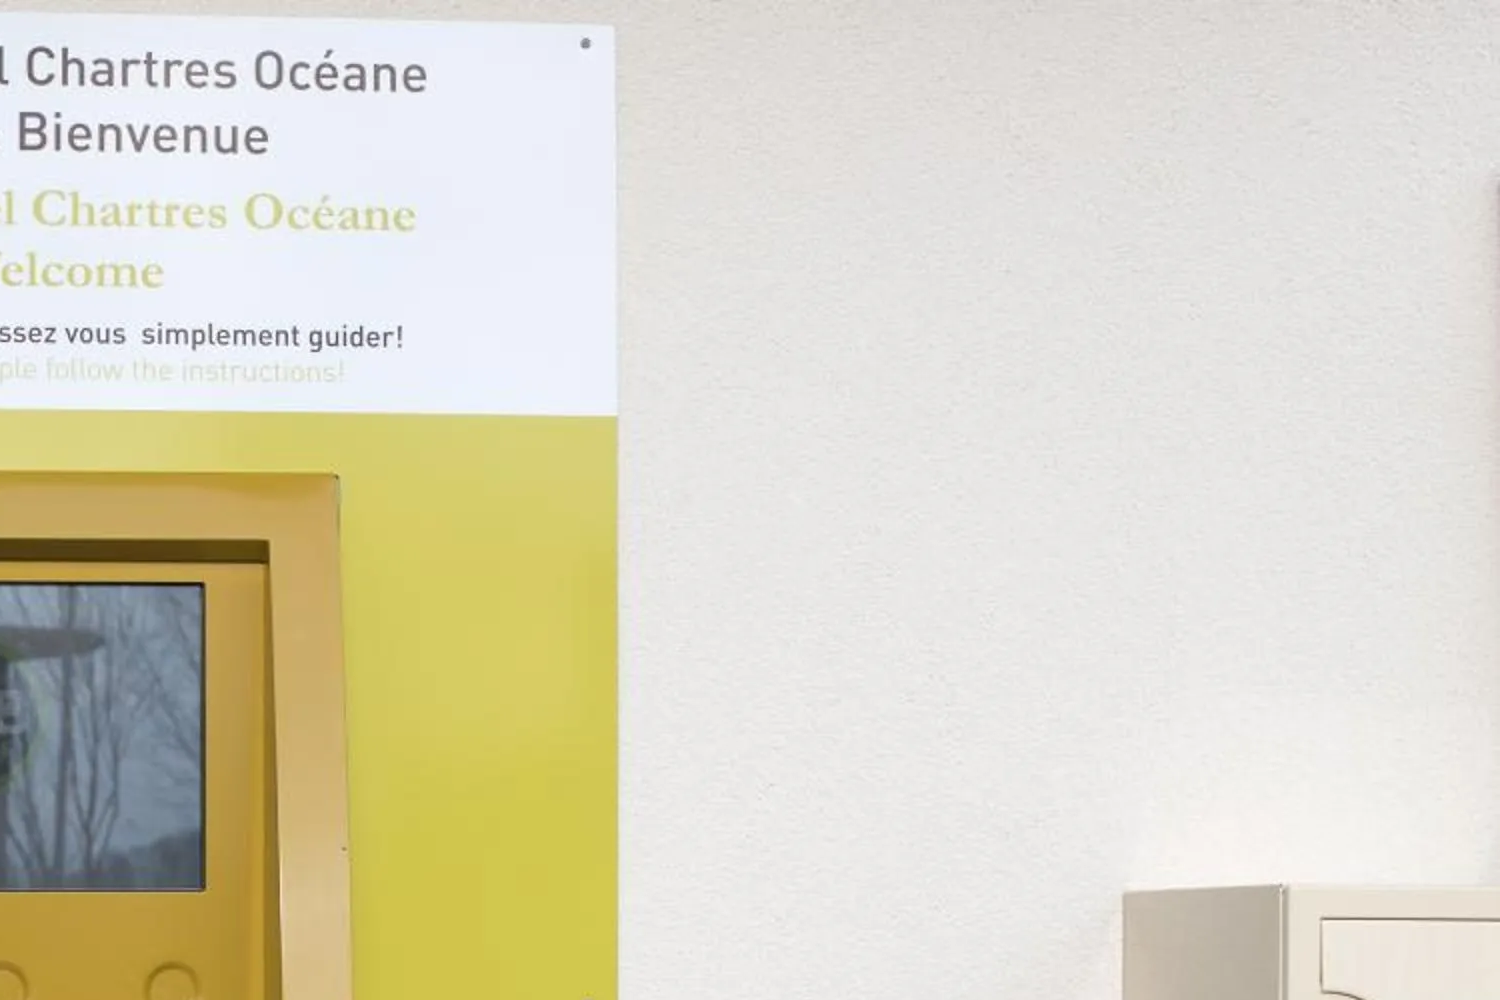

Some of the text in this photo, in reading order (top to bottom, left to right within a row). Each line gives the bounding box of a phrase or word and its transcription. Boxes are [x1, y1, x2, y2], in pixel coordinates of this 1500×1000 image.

[26, 46, 237, 88] Chartres
[255, 49, 427, 92] Océane
[18, 111, 269, 155] Bienvenue
[31, 189, 227, 228] Chartres
[244, 193, 416, 231] Océane
[65, 326, 126, 344] vous
[142, 322, 301, 351] simplement
[308, 325, 403, 353] guider!
[46, 357, 124, 382] follow
[133, 358, 168, 381] the
[181, 359, 346, 384] instructions!
